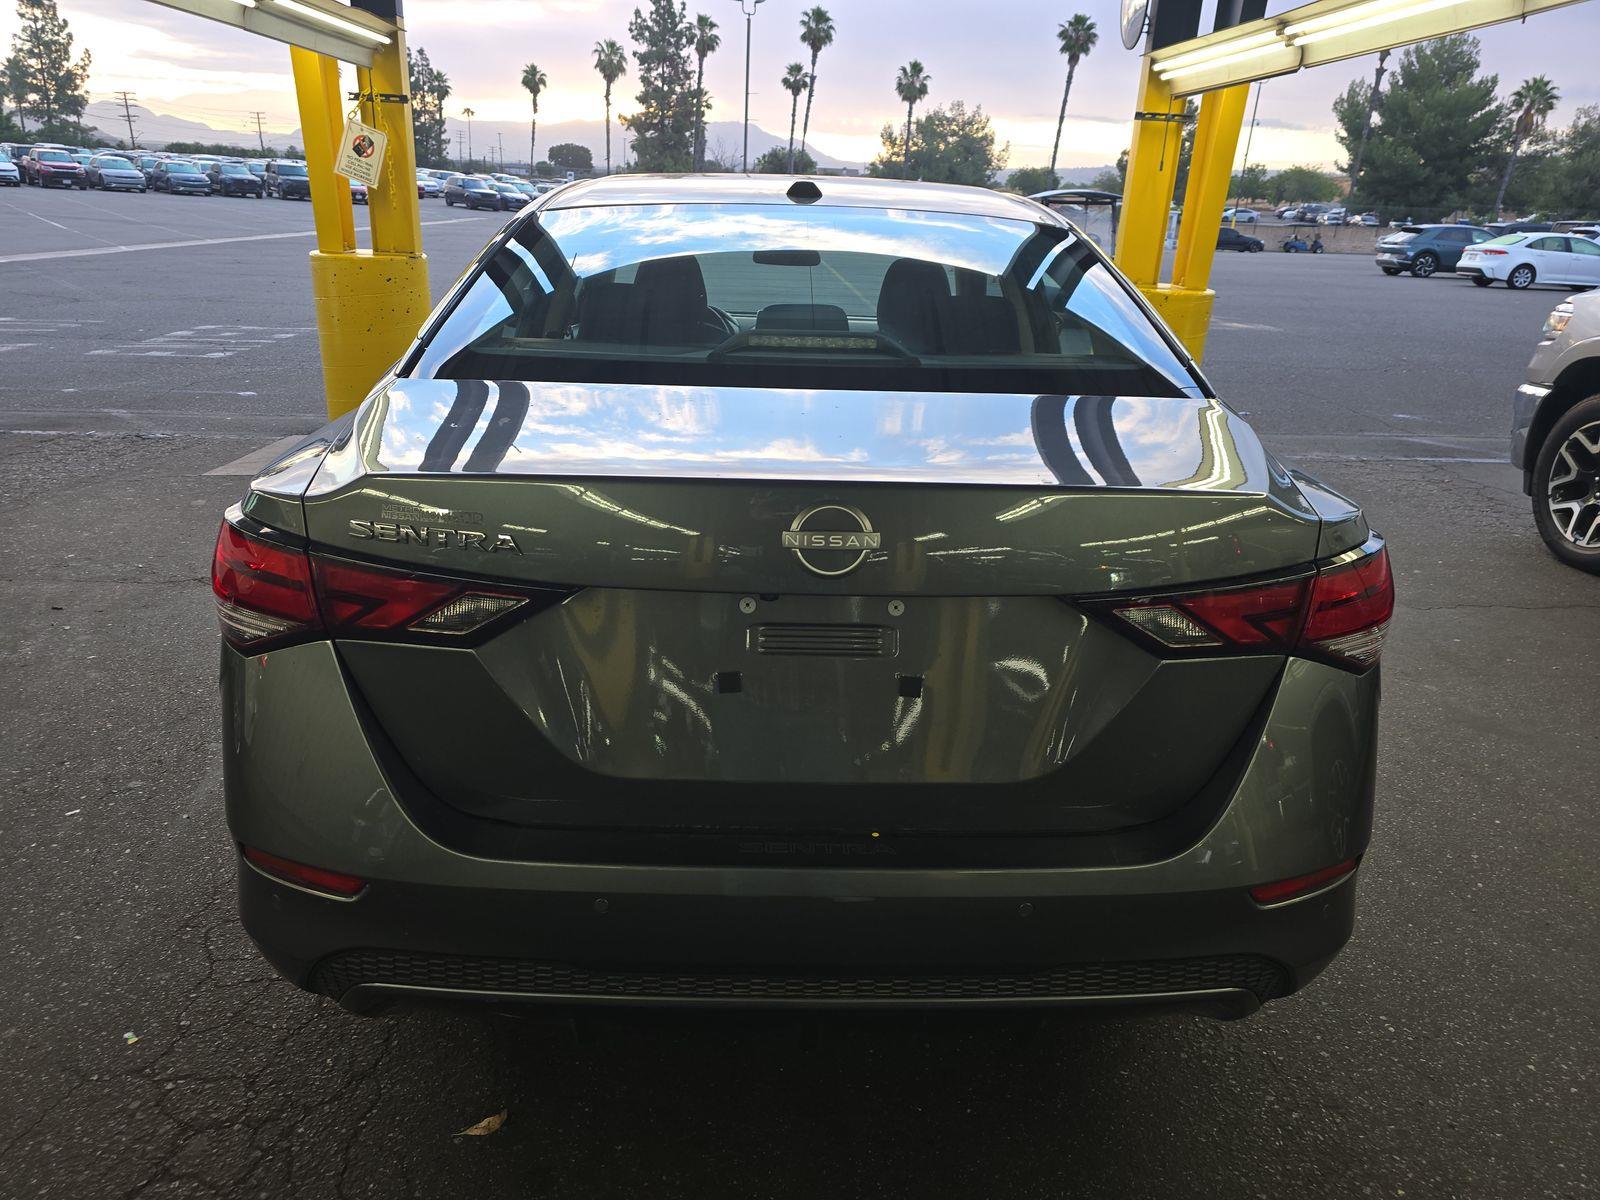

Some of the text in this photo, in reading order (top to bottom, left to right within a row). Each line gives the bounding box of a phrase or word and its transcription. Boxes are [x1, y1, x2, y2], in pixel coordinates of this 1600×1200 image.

[352, 167, 372, 177] ALLOWED
[356, 164, 371, 172] PHONE
[353, 173, 373, 183] WORKING
[381, 511, 421, 521] NISSAN
[349, 519, 524, 556] SENTRA
[784, 533, 879, 548] NISSAN
[737, 839, 897, 856] SENTRA
